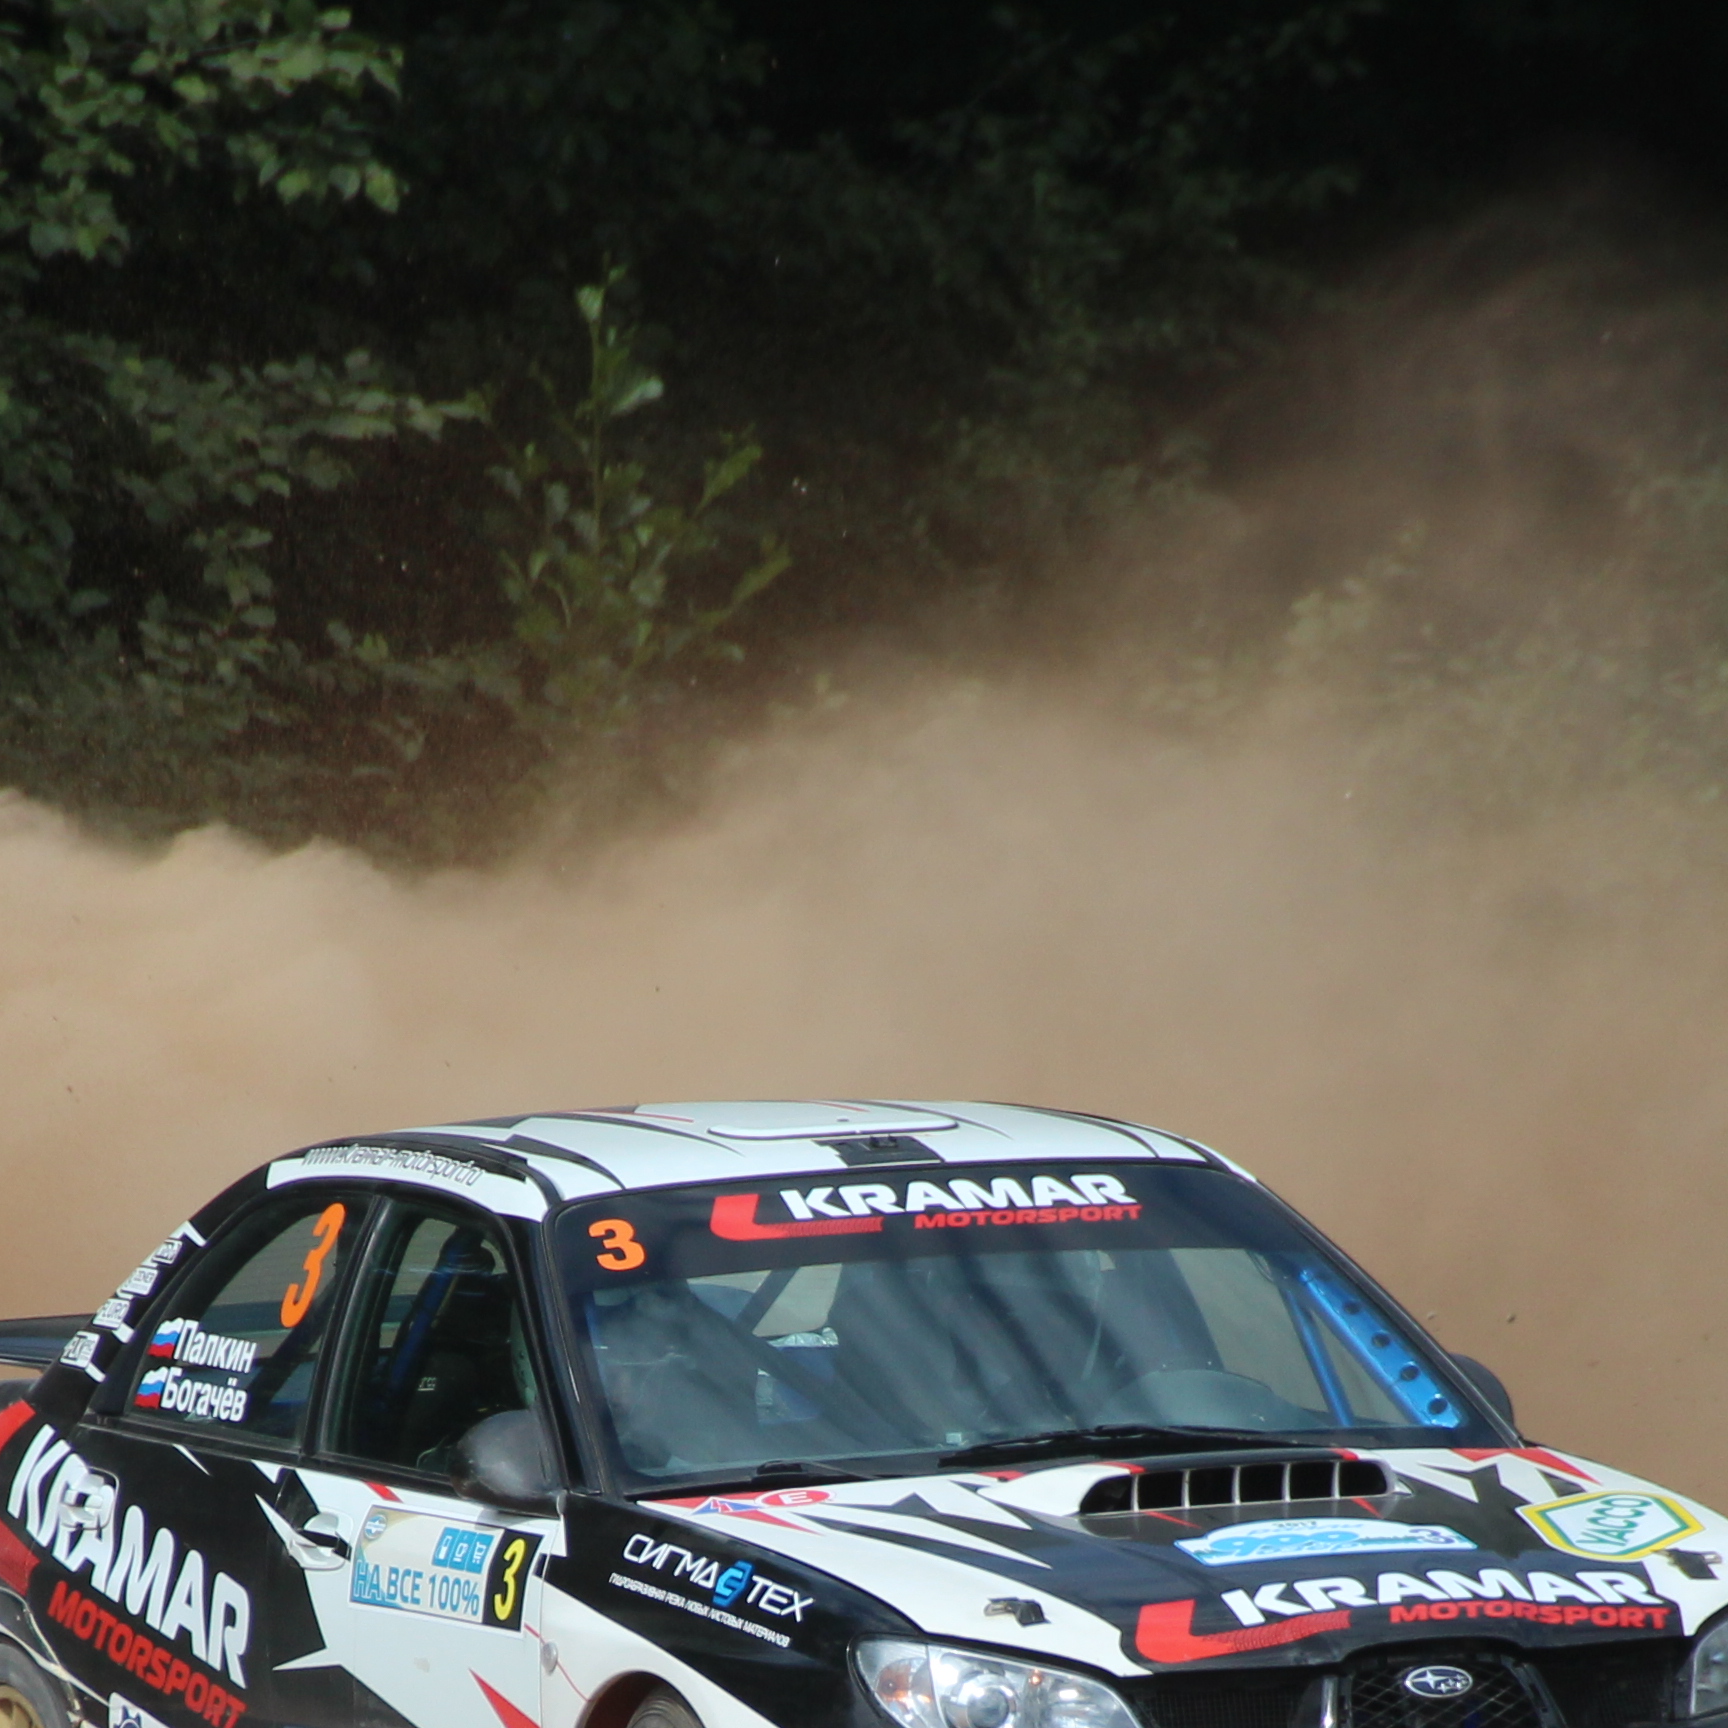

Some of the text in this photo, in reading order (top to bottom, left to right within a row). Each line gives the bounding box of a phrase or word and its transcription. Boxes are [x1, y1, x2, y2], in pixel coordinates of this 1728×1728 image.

[780, 1173, 1139, 1221] KRAMAR
[914, 1204, 1143, 1230] MOTORSPORT
[281, 1202, 346, 1328] 3
[588, 1218, 647, 1272] 3
[173, 1318, 258, 1374] Палкин
[160, 1366, 248, 1422] Богачёв
[1575, 1497, 1653, 1546] YACCO
[6, 1423, 251, 1690] KRAMAR
[493, 1537, 527, 1622] 3
[623, 1533, 815, 1623] СИГМА ТЕХ
[353, 1559, 480, 1617] НА ВСЕ 100%
[1220, 1568, 1664, 1627] KRAMAR
[1389, 1601, 1671, 1629] MOTORSPORT
